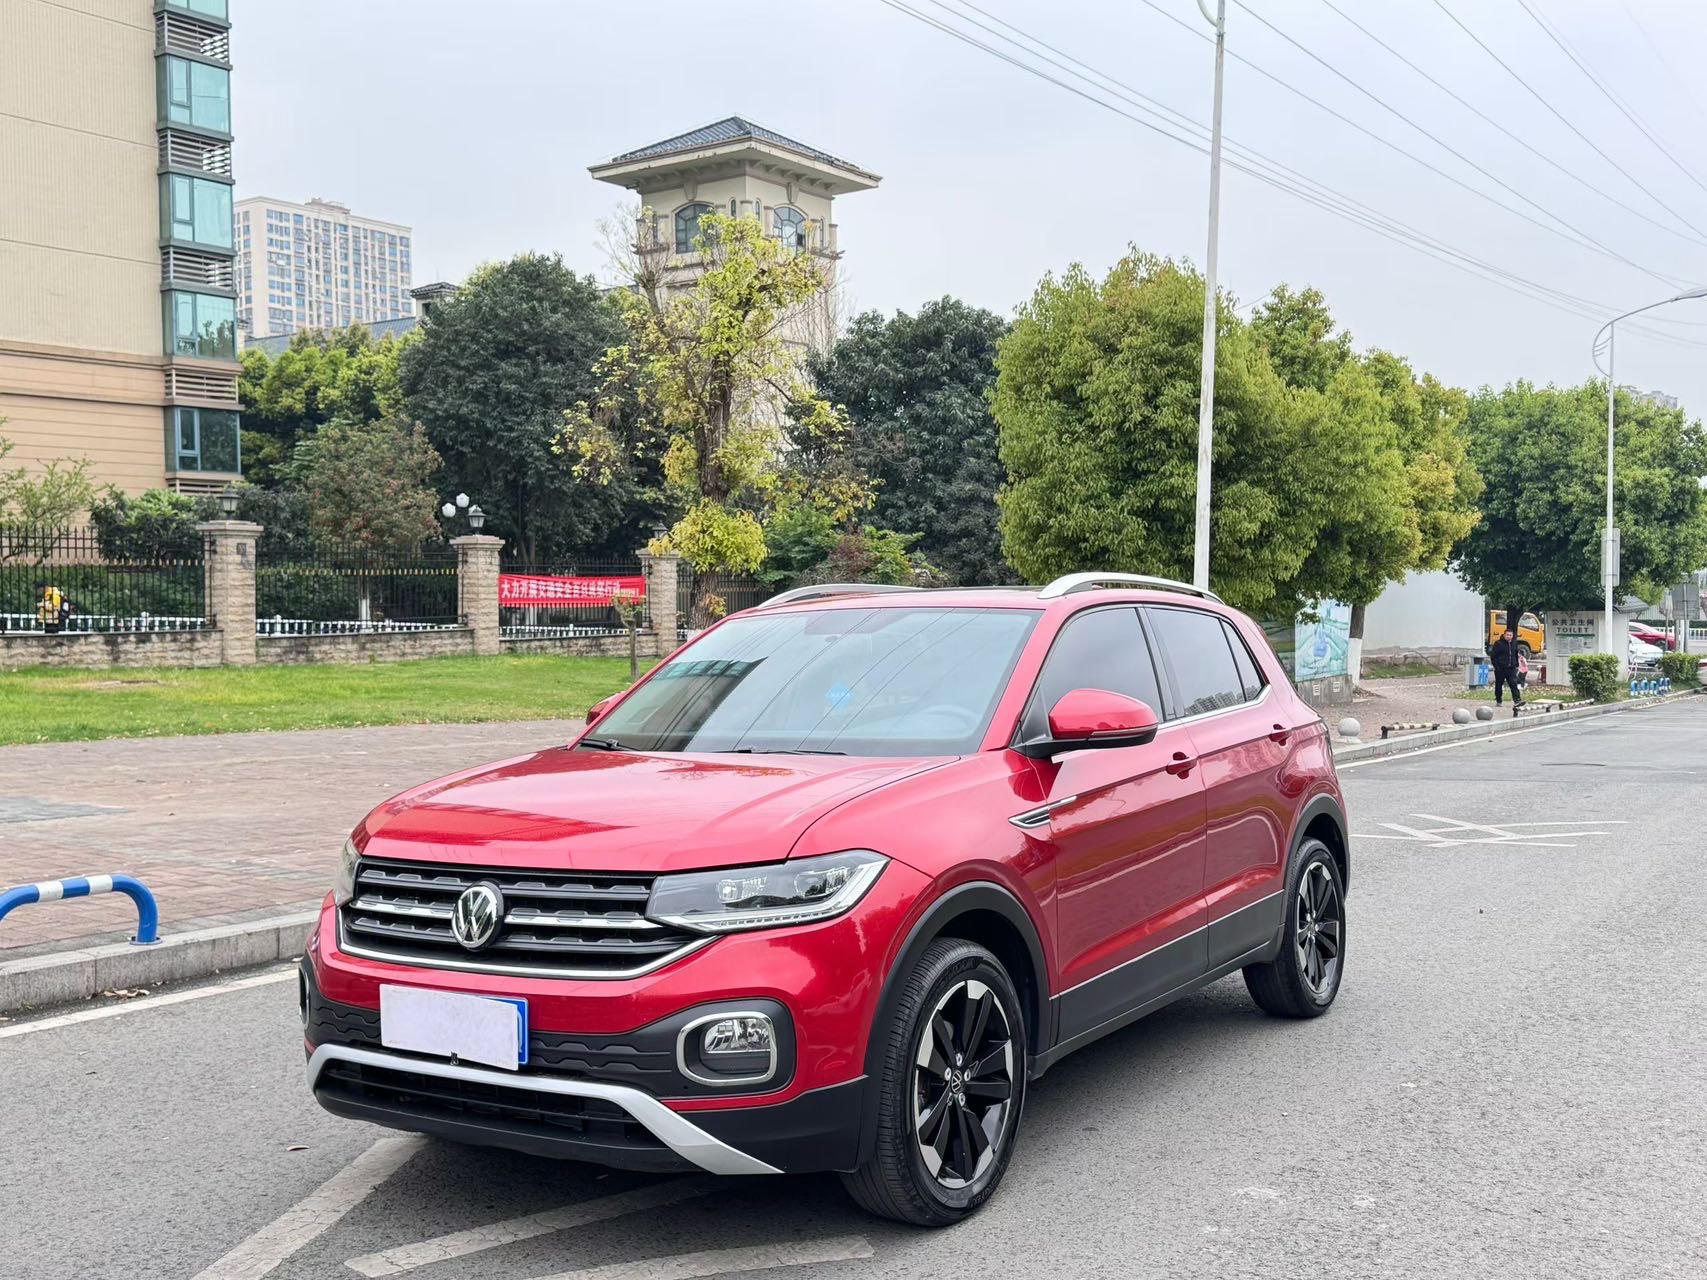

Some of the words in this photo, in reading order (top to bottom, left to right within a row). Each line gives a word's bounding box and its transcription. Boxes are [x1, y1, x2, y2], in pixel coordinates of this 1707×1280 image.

[1552, 618, 1595, 626] 公共卫生间
[451, 884, 500, 949] VW
